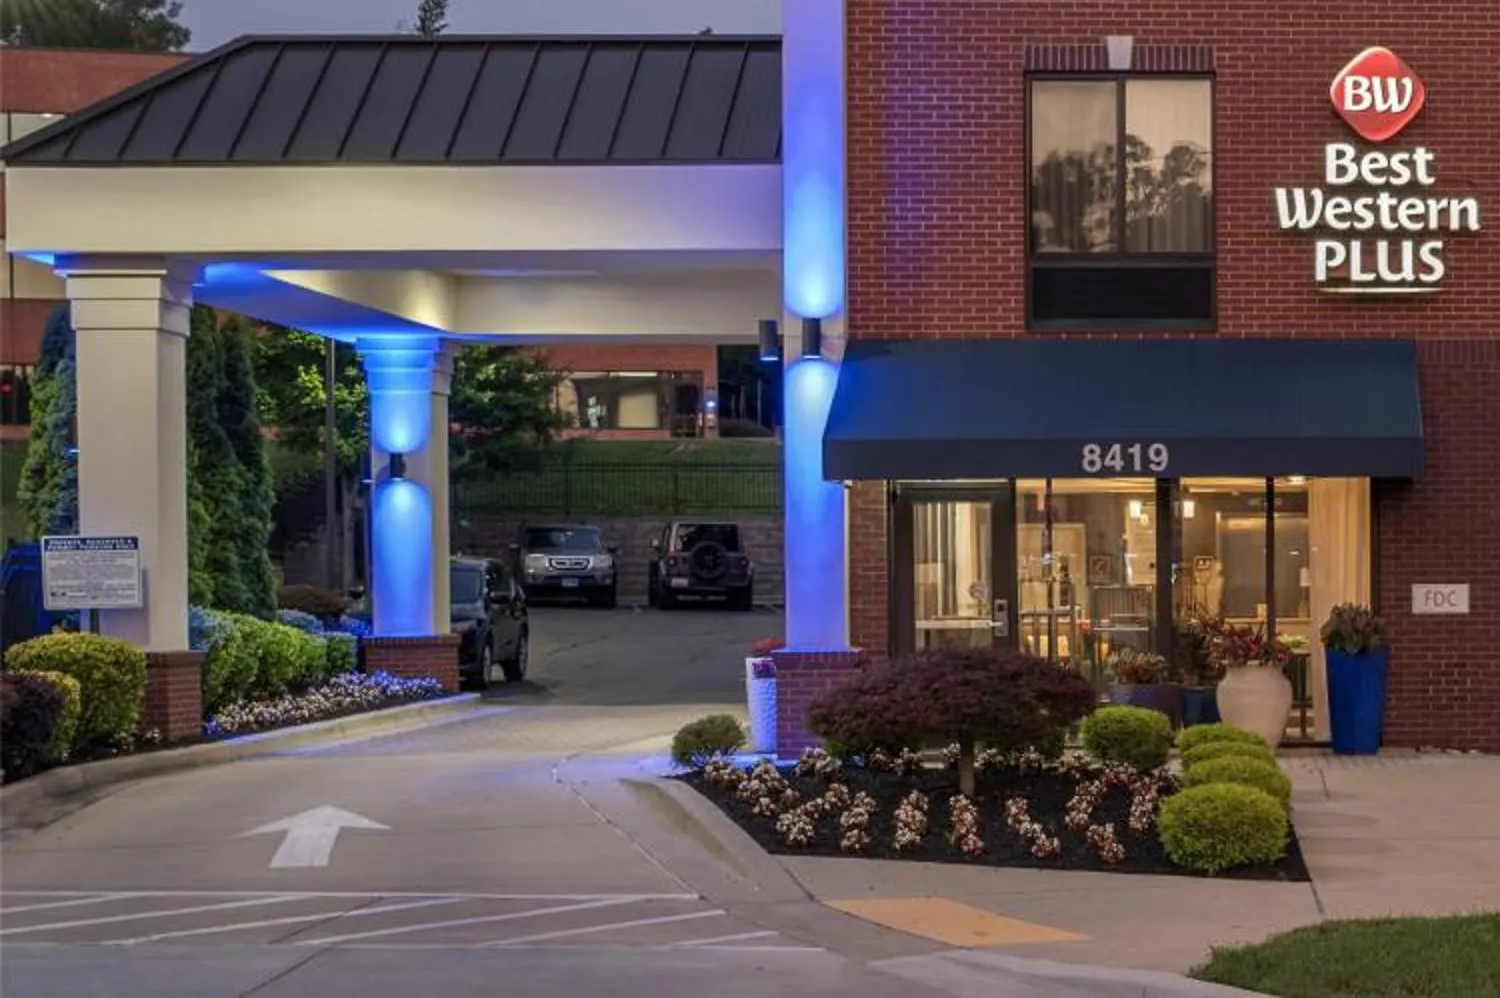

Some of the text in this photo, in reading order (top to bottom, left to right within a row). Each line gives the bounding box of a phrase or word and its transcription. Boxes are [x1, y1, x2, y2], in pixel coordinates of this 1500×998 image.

[1343, 75, 1413, 113] BW
[1325, 143, 1436, 186] Best
[1274, 187, 1481, 231] Western
[1314, 239, 1446, 282] PLUS
[1082, 443, 1169, 473] 8419
[1424, 589, 1458, 607] FDC
